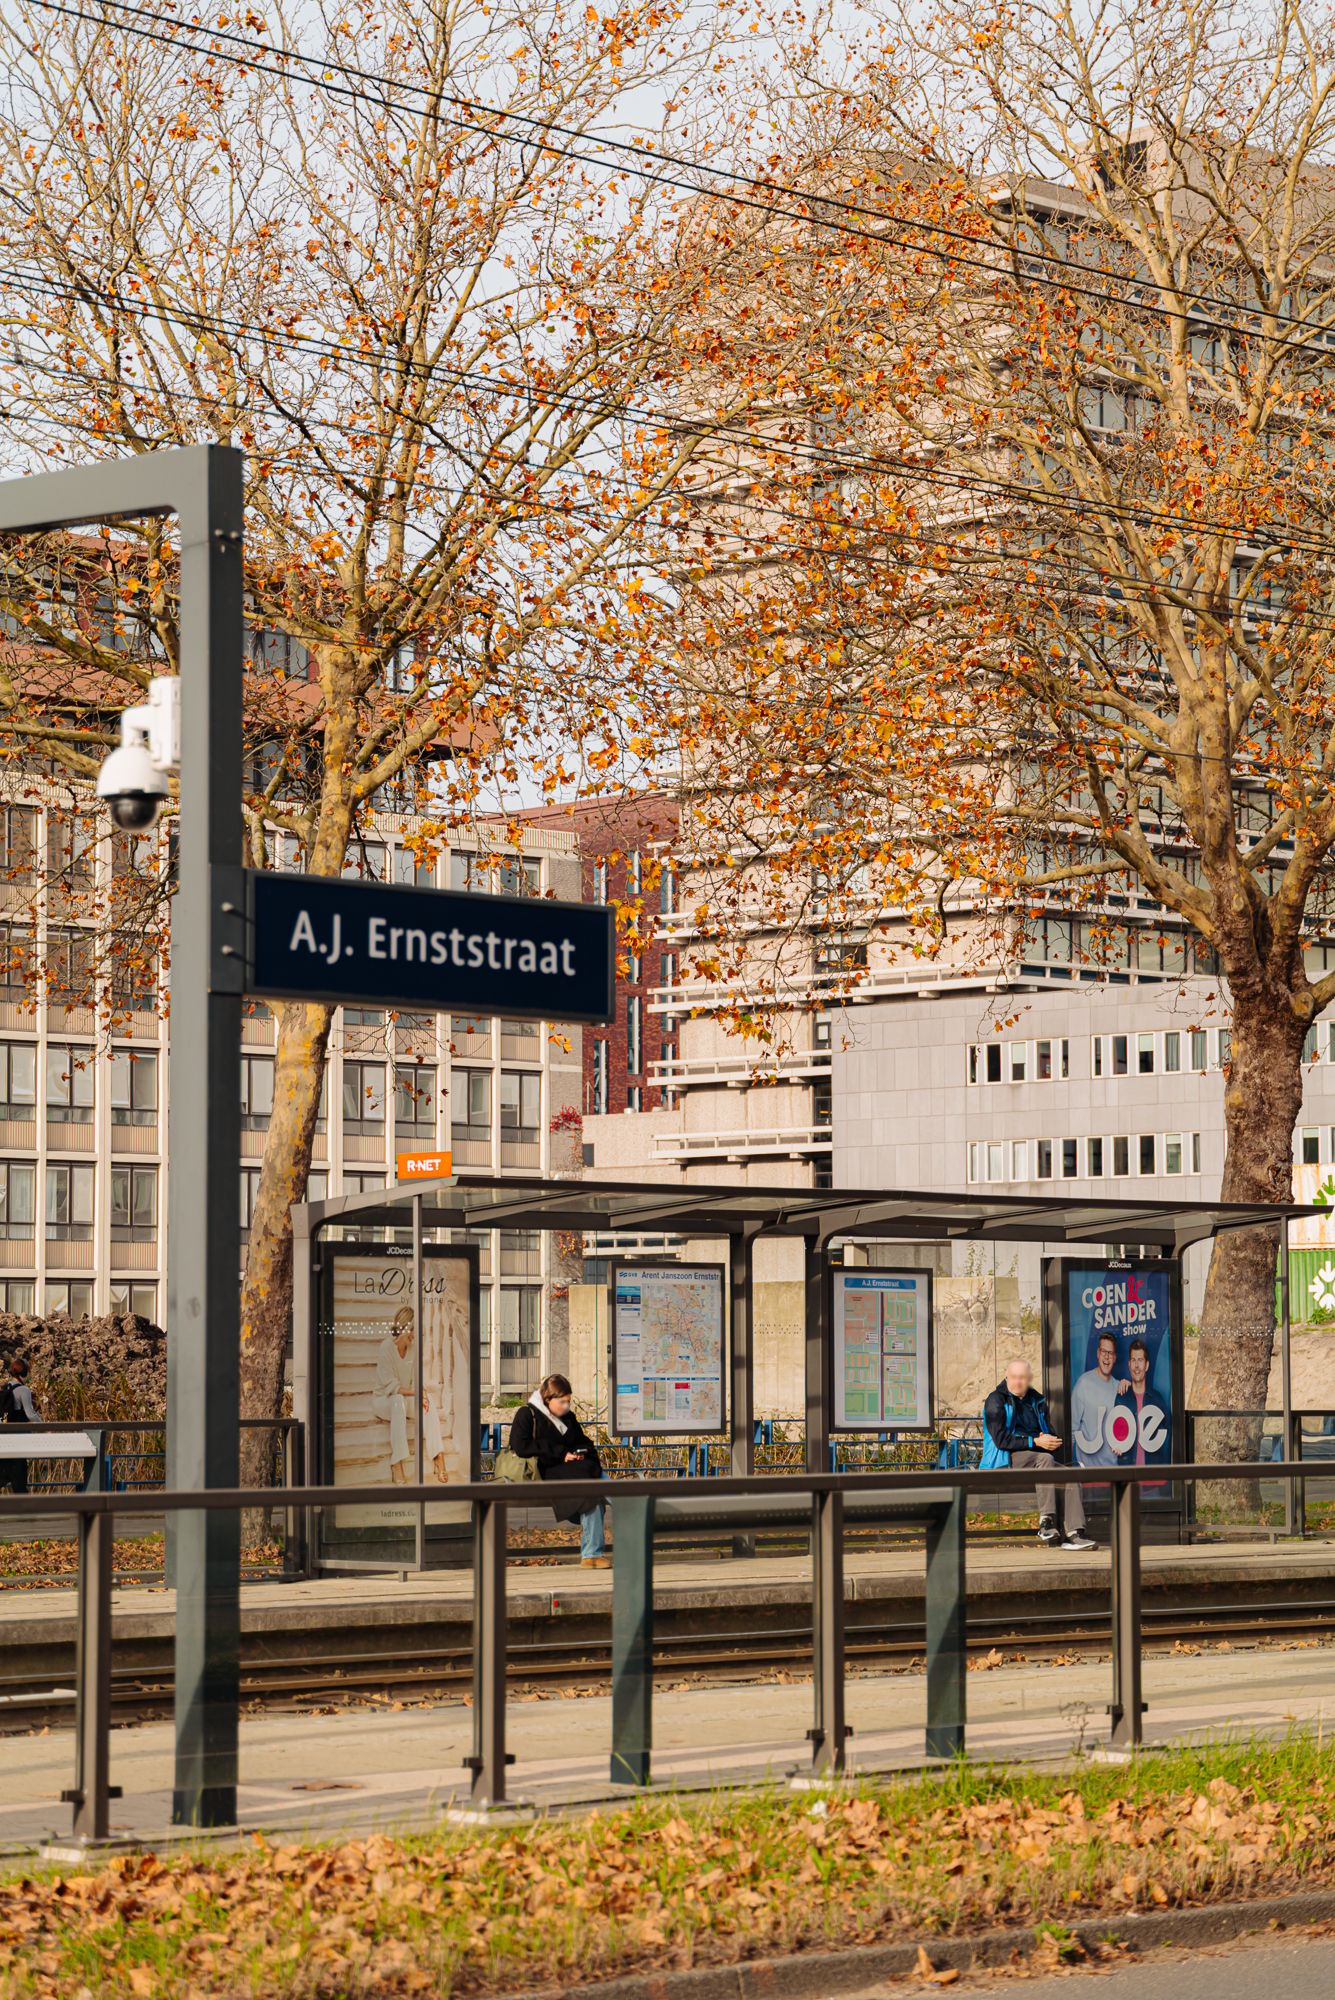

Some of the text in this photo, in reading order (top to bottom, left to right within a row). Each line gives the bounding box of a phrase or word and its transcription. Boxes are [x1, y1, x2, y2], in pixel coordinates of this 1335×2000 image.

[289, 909, 577, 977] A.J. Ernststraat
[386, 1246, 415, 1255] JCDecau
[1108, 1261, 1132, 1269] JCDecaux
[1082, 1288, 1126, 1310] COEN
[1094, 1299, 1157, 1329] SANDER
[1122, 1323, 1147, 1337] show
